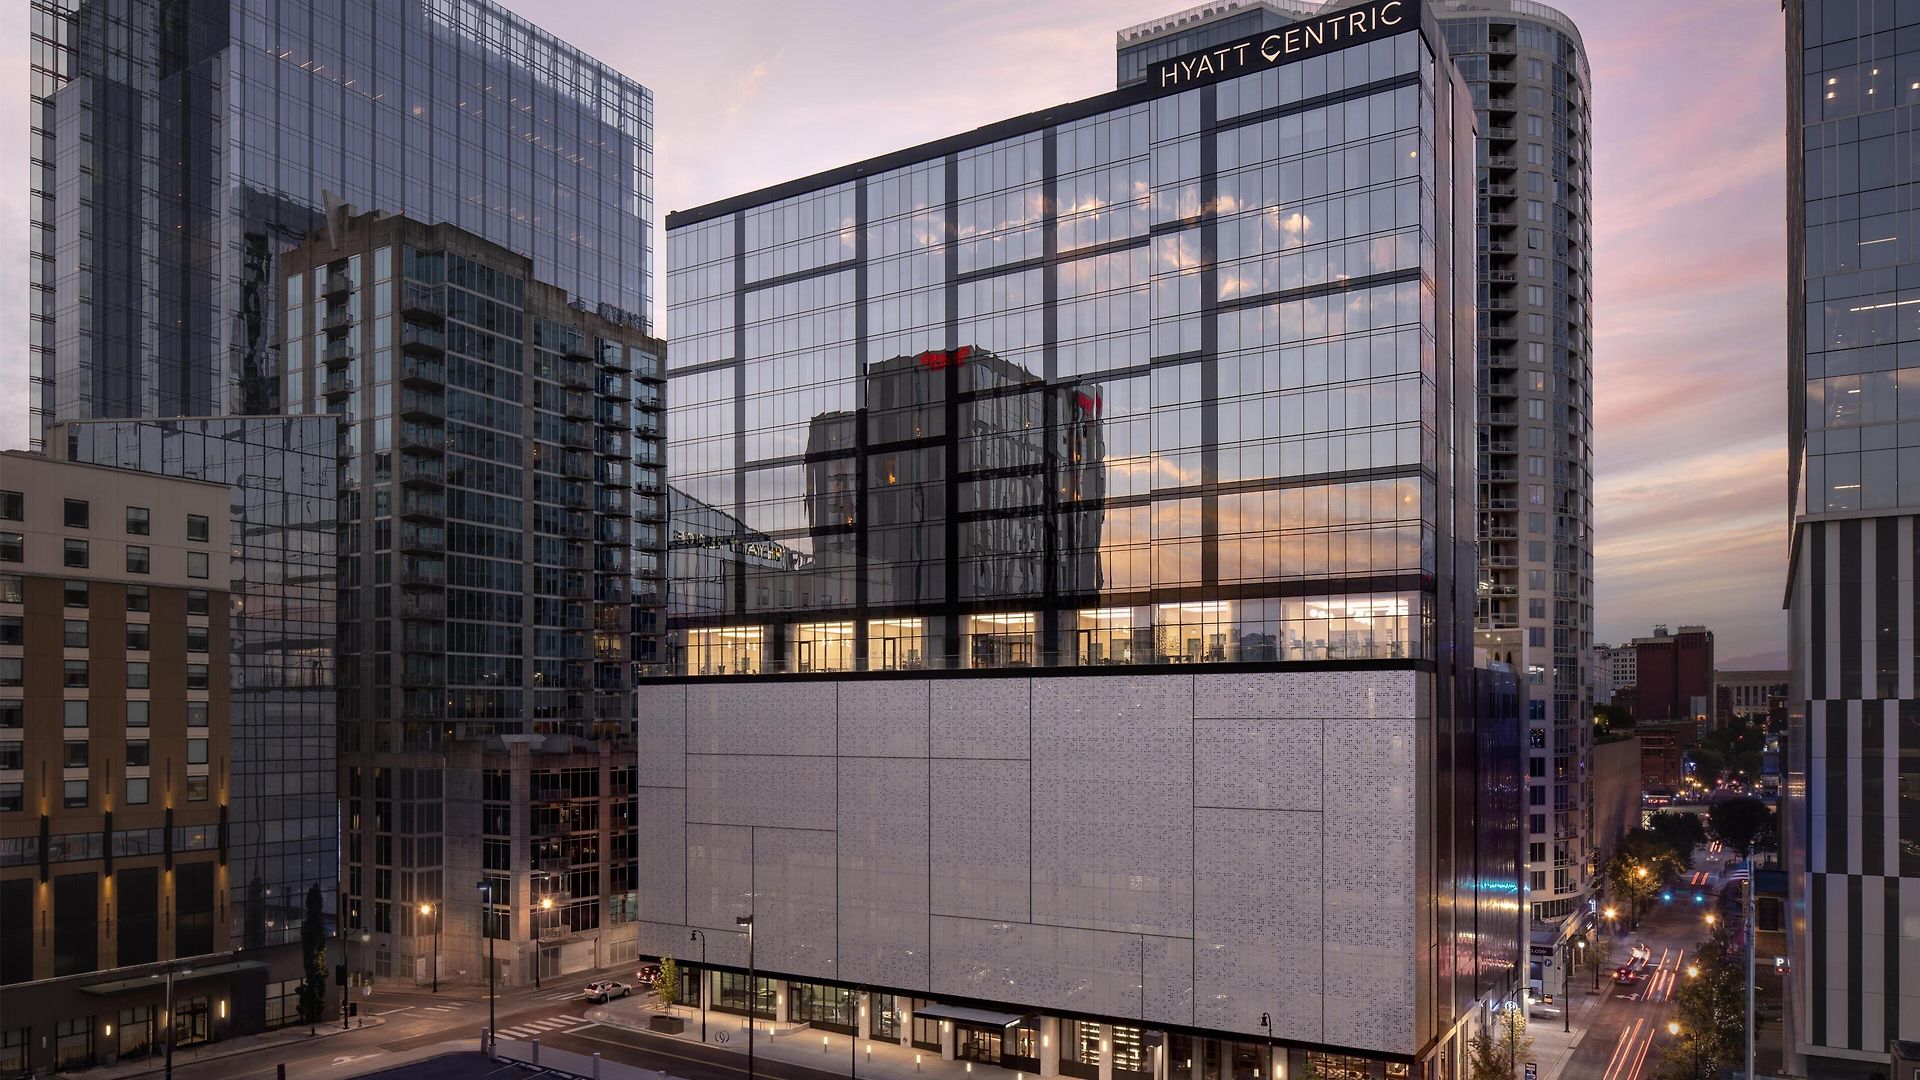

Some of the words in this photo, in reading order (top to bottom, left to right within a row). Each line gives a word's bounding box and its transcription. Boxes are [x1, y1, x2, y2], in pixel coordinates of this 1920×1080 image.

[1161, 43, 1251, 87] HYATT
[1261, 1, 1402, 62] CENTRIC
[1776, 957, 1784, 966] P
